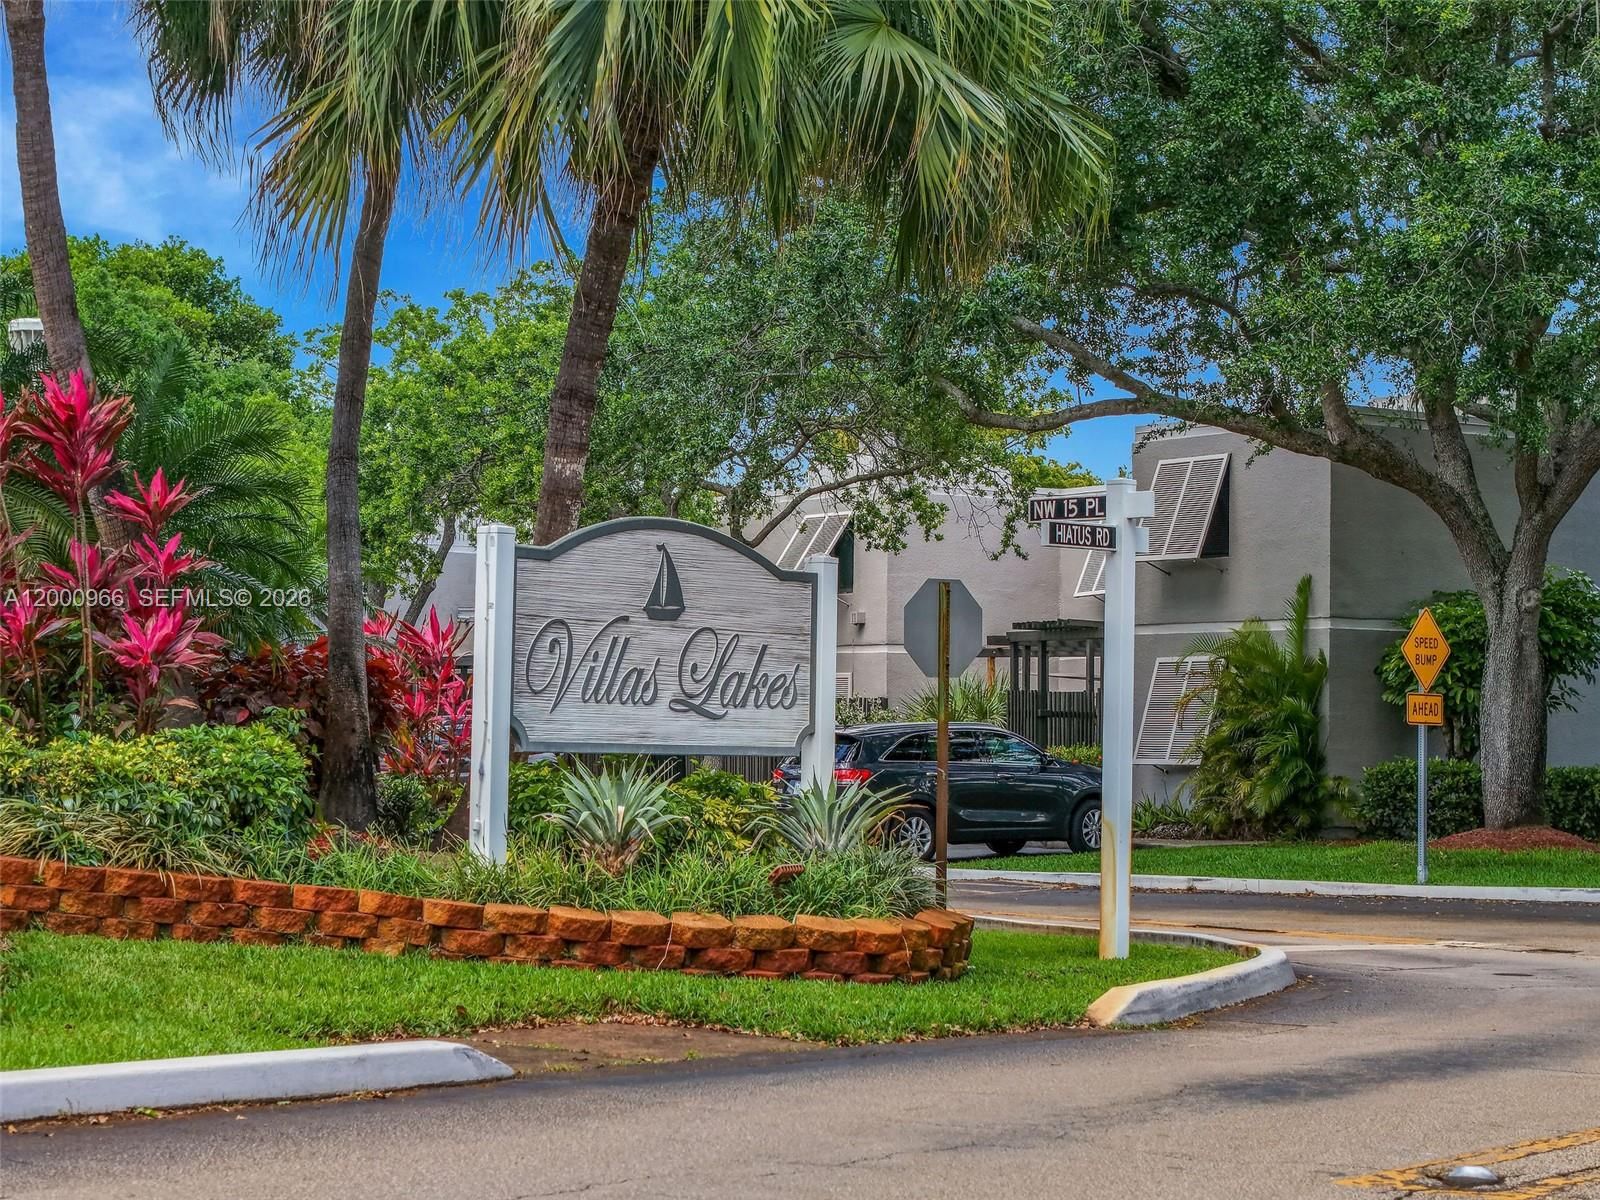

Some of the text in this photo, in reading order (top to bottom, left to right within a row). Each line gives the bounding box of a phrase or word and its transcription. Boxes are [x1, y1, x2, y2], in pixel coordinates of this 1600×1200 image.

[1033, 498, 1104, 519] NW 15 PL
[1055, 523, 1110, 547] HIATUS RD
[1414, 637, 1439, 649] SPEED
[525, 617, 800, 720] Villas Lakes
[1415, 653, 1438, 666] BUMP
[1412, 702, 1439, 717] AHEAD
